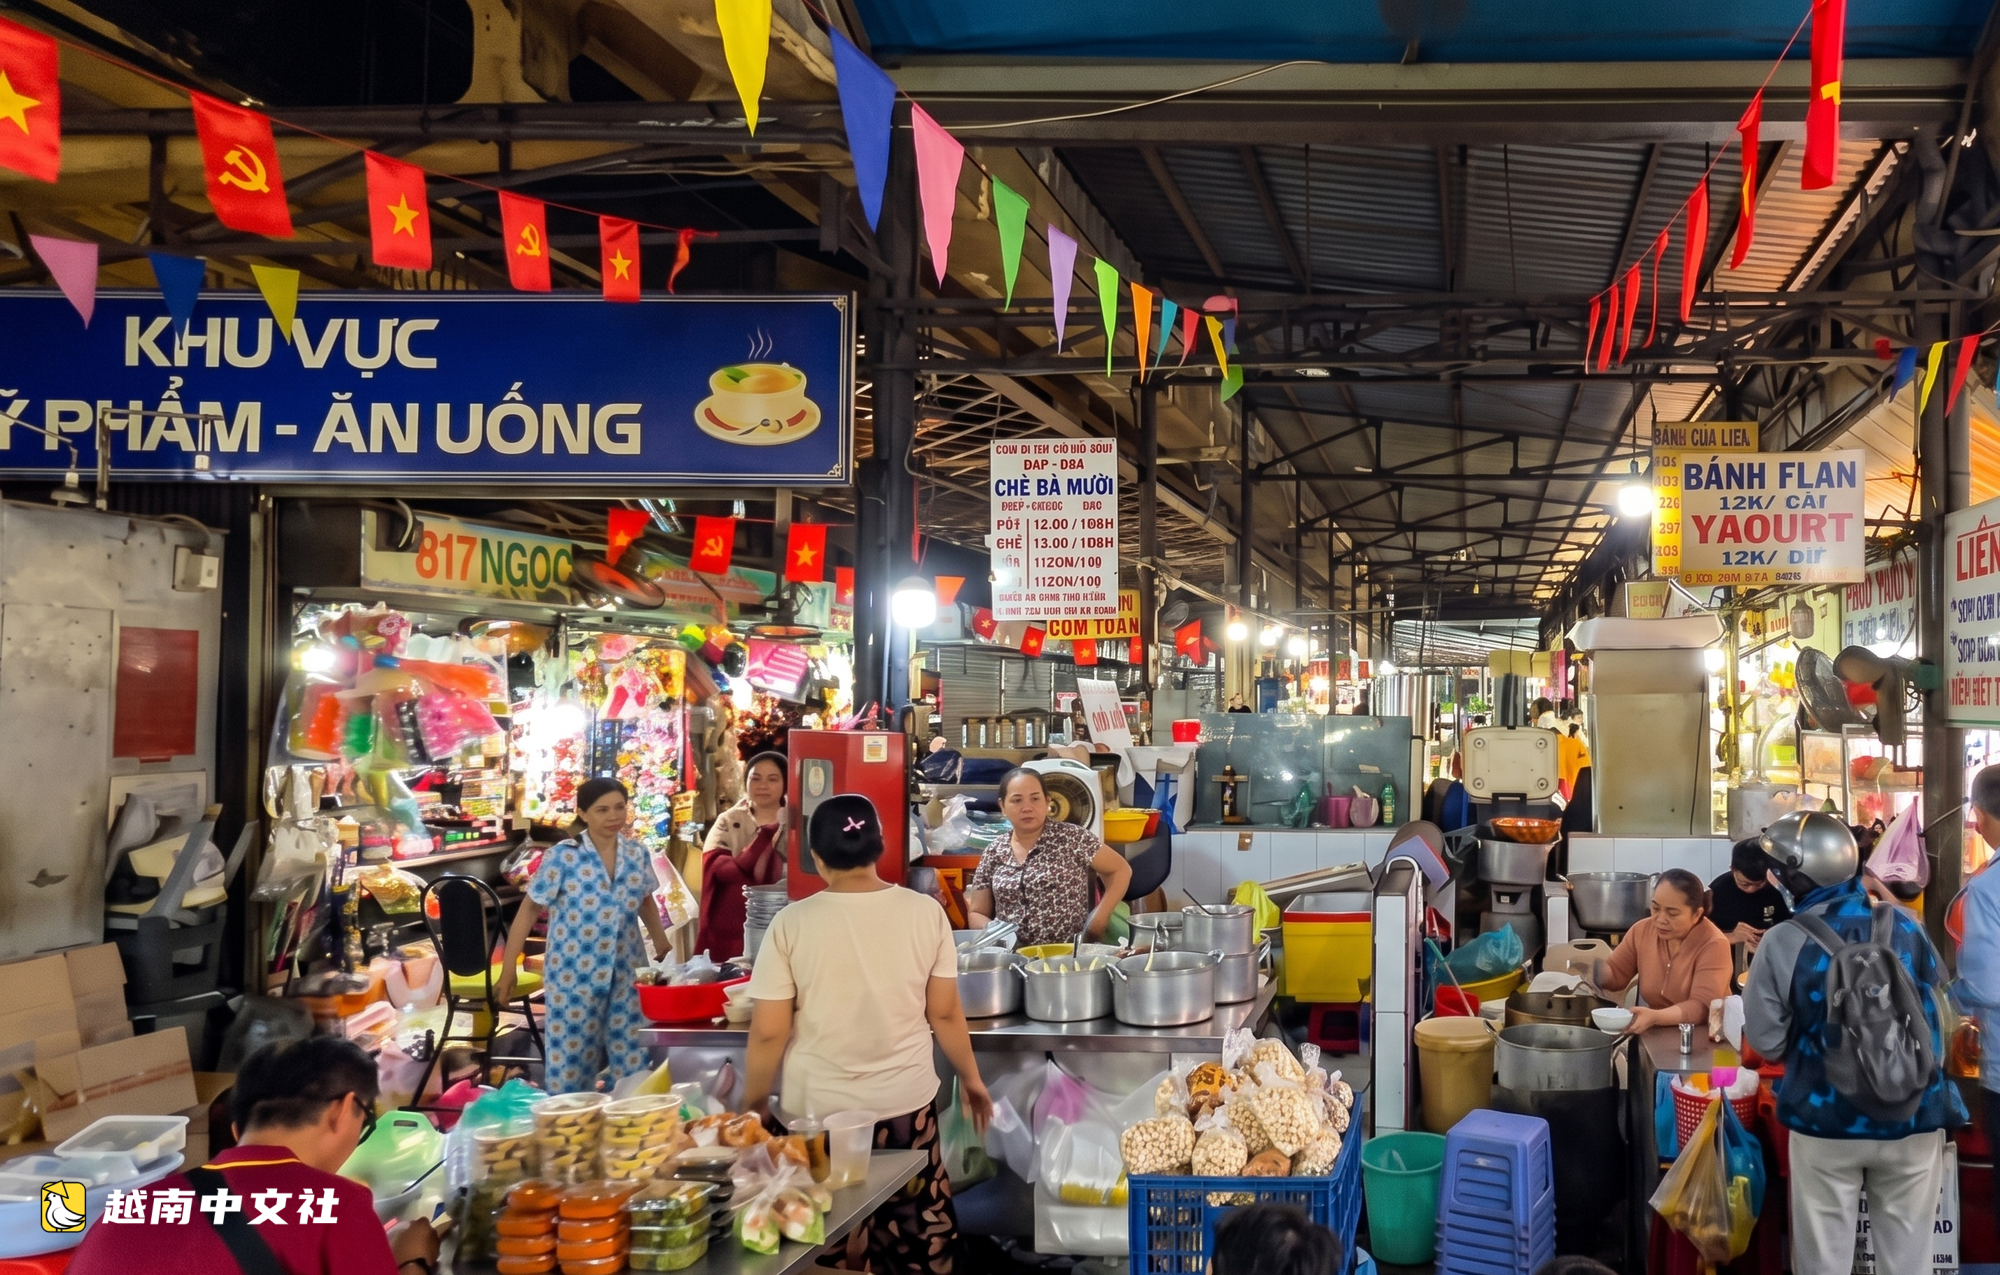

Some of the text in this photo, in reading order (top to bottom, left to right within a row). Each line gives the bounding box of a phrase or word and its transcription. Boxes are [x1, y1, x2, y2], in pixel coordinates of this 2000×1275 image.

[125, 316, 440, 379] KHU VỰC
[44, 376, 261, 452] PHẨM
[312, 392, 420, 453] ĂN
[436, 382, 642, 455] UỐNG
[995, 473, 1113, 496] CHÈ BÀ MƯỜI
[1684, 456, 1856, 490] BÁNH FLAN
[1659, 497, 1680, 509] 226
[1719, 495, 1776, 510] 12K/
[1034, 518, 1068, 530] 12.00
[1691, 513, 1853, 544] YAOURT
[1034, 537, 1068, 549] 13.00
[415, 530, 477, 582] 817
[1722, 550, 1778, 566] 12K/
